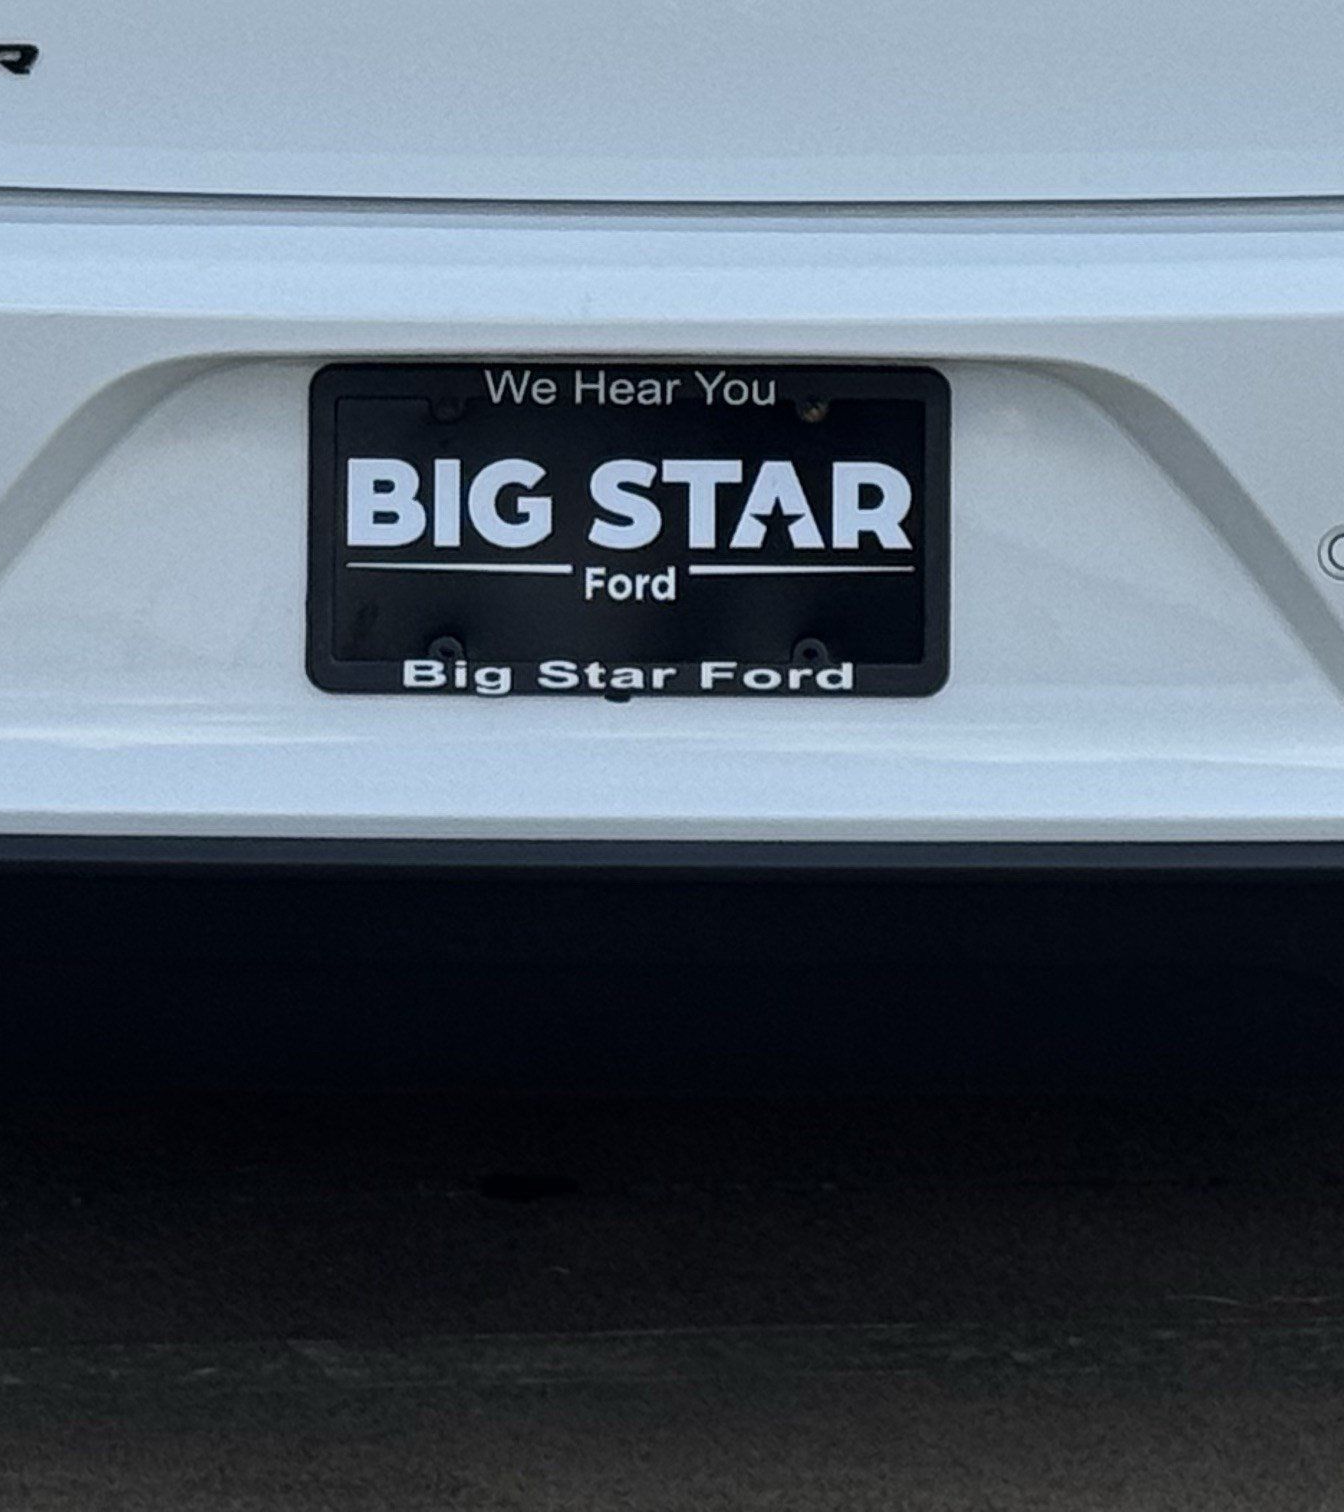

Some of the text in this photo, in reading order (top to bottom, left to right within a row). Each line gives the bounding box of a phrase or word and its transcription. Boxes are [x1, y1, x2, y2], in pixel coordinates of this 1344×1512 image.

[485, 369, 777, 407] We Hear You
[346, 457, 913, 551] BIG STAR
[584, 565, 677, 602] Ford
[401, 658, 855, 696] Big Star Ford
